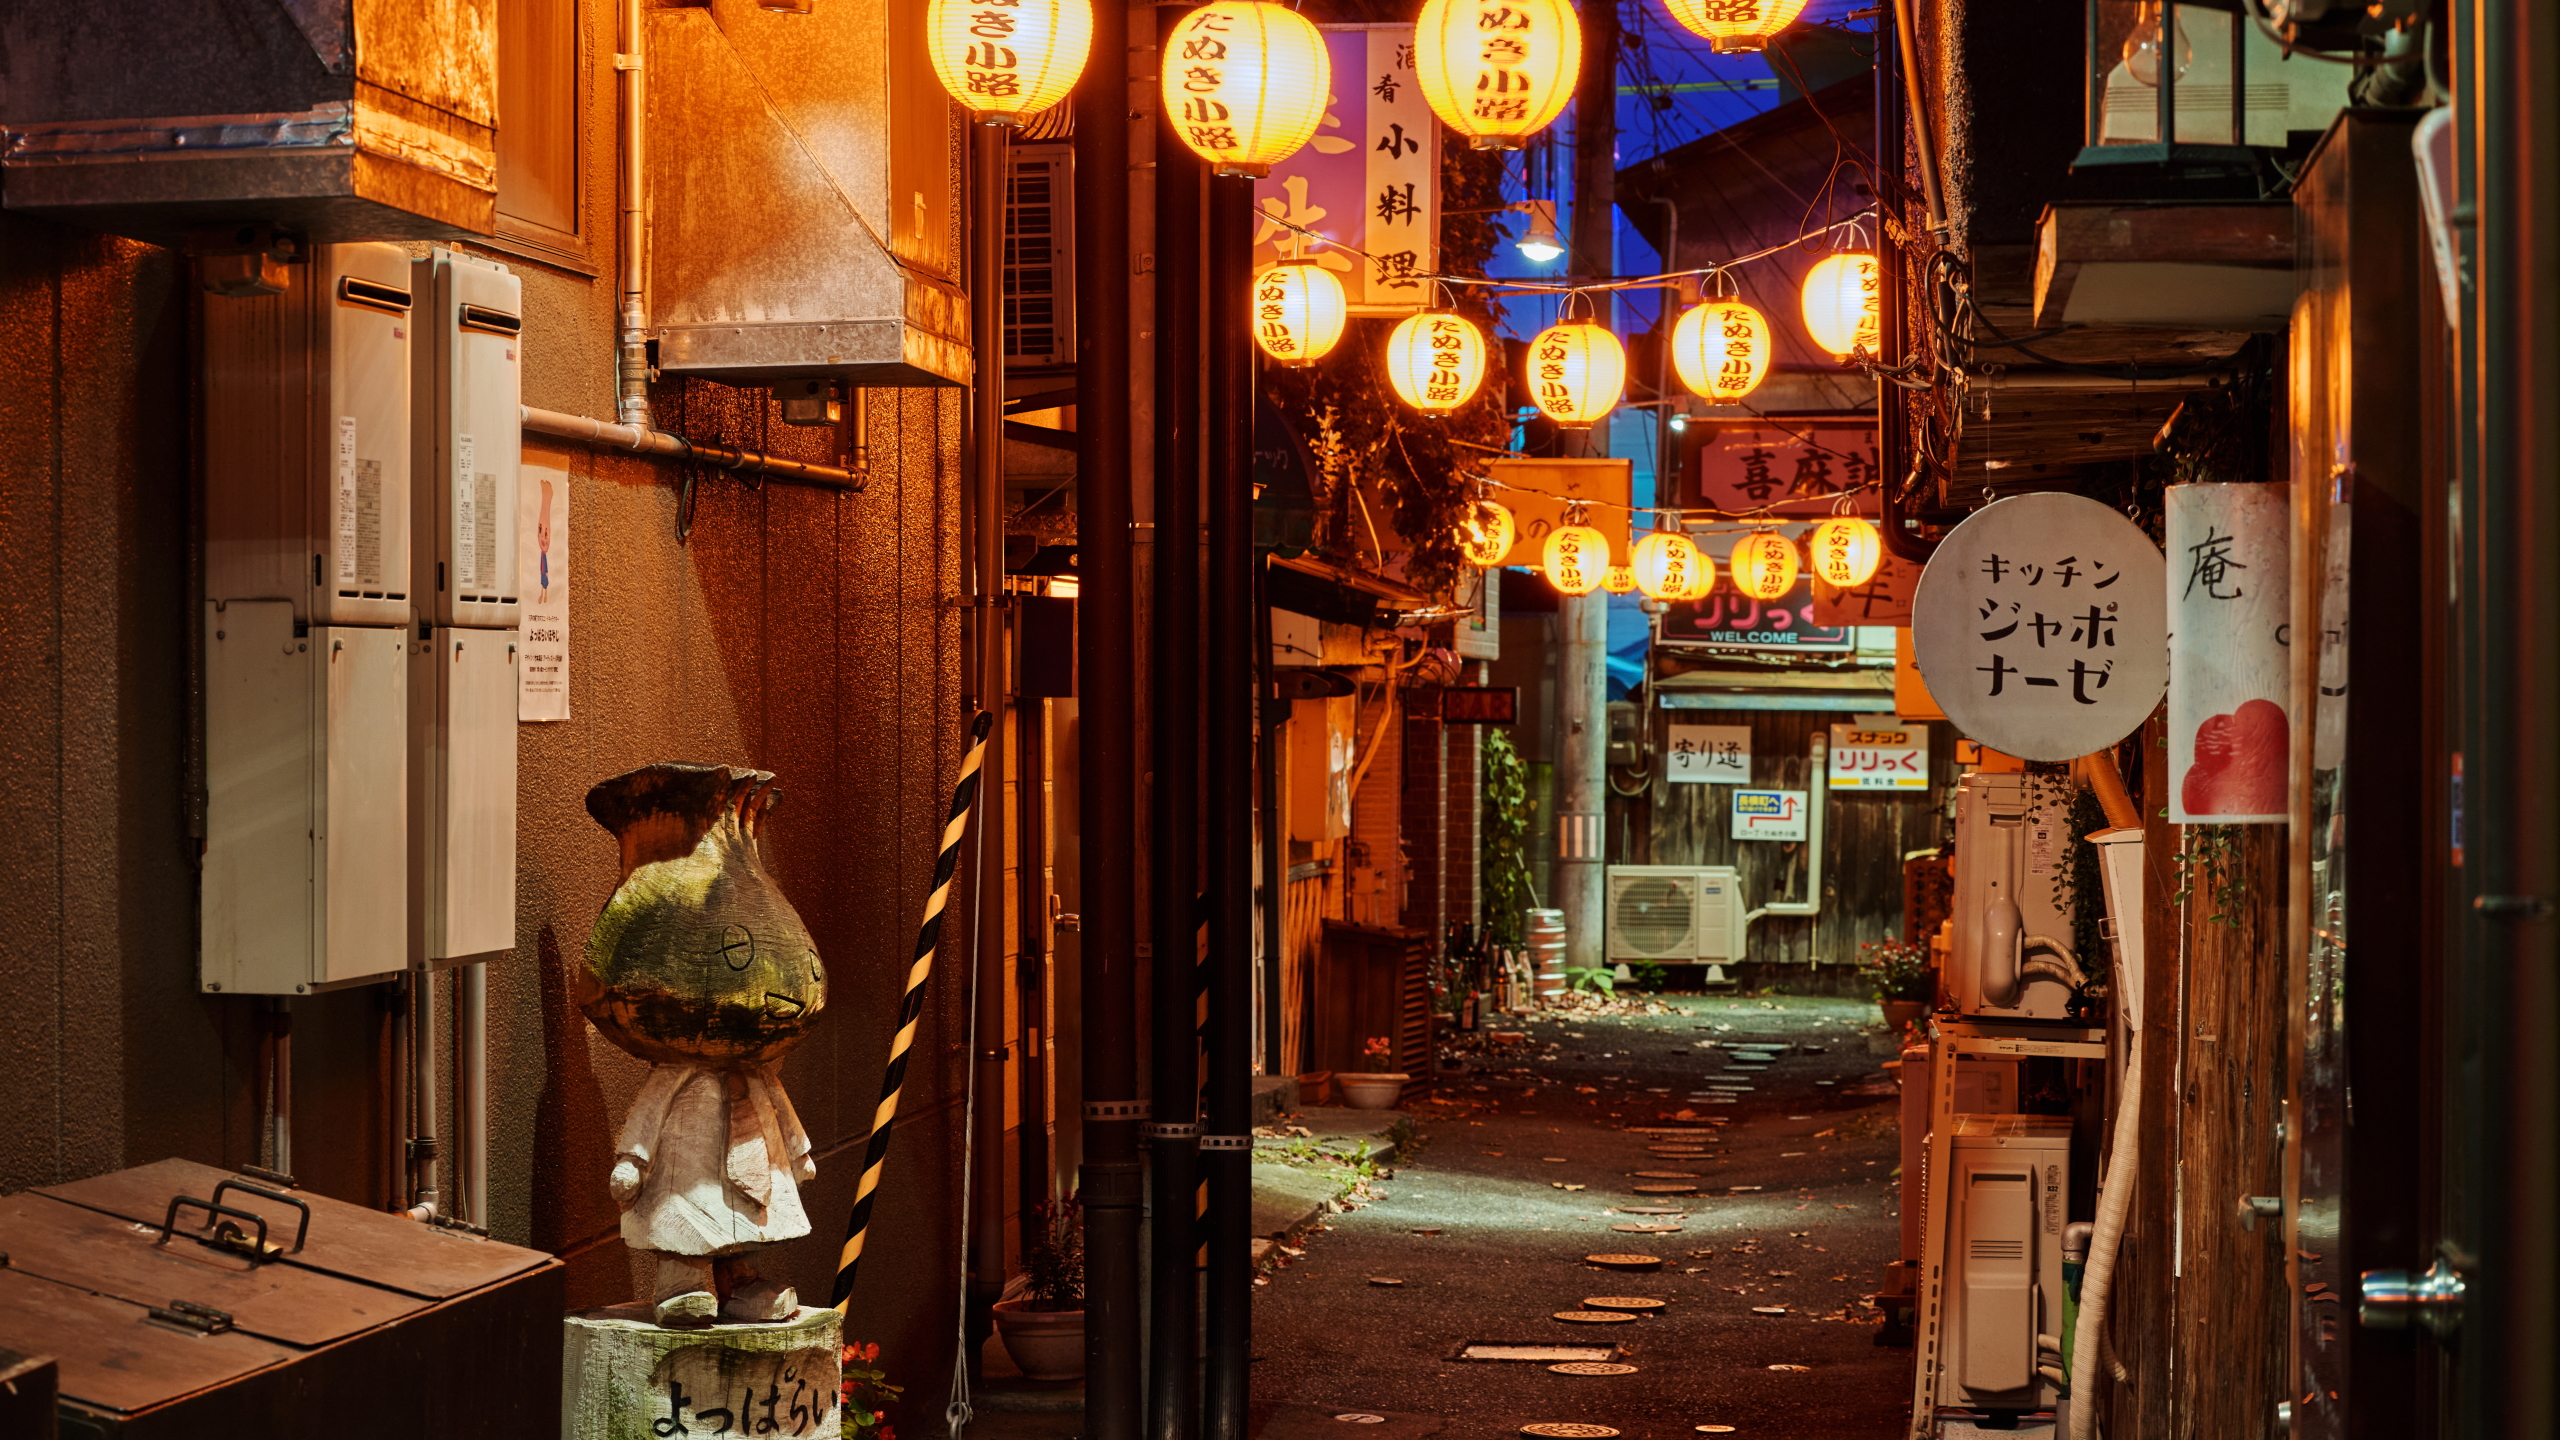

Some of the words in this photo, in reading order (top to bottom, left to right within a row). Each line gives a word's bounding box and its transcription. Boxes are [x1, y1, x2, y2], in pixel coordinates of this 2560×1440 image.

[965, 0, 1019, 96] き小路
[1474, 0, 1530, 120] ぬき小路
[1182, 12, 1238, 149] たぬき小路
[1259, 272, 1296, 352] たぬき小路
[1427, 320, 1461, 400] たぬき小路
[1539, 331, 1575, 413] たぬき小路
[1718, 309, 1753, 390] たぬき小路
[1559, 532, 1582, 588] たぬき小路
[1662, 539, 1686, 593] たぬき小路
[1760, 540, 1784, 594] たぬき小路
[1829, 525, 1851, 581] たぬき小路
[1981, 553, 2120, 589] キッチン
[2183, 526, 2247, 601] 庵
[1710, 631, 1798, 644] WELCOME
[1979, 598, 2118, 649] ジャポ
[1448, 692, 1511, 720] BAR
[1976, 654, 2113, 705] ナーゼ
[1673, 738, 1744, 769] 寄り道
[1849, 732, 1907, 743] スナック
[653, 1365, 838, 1438] よっぱらい
